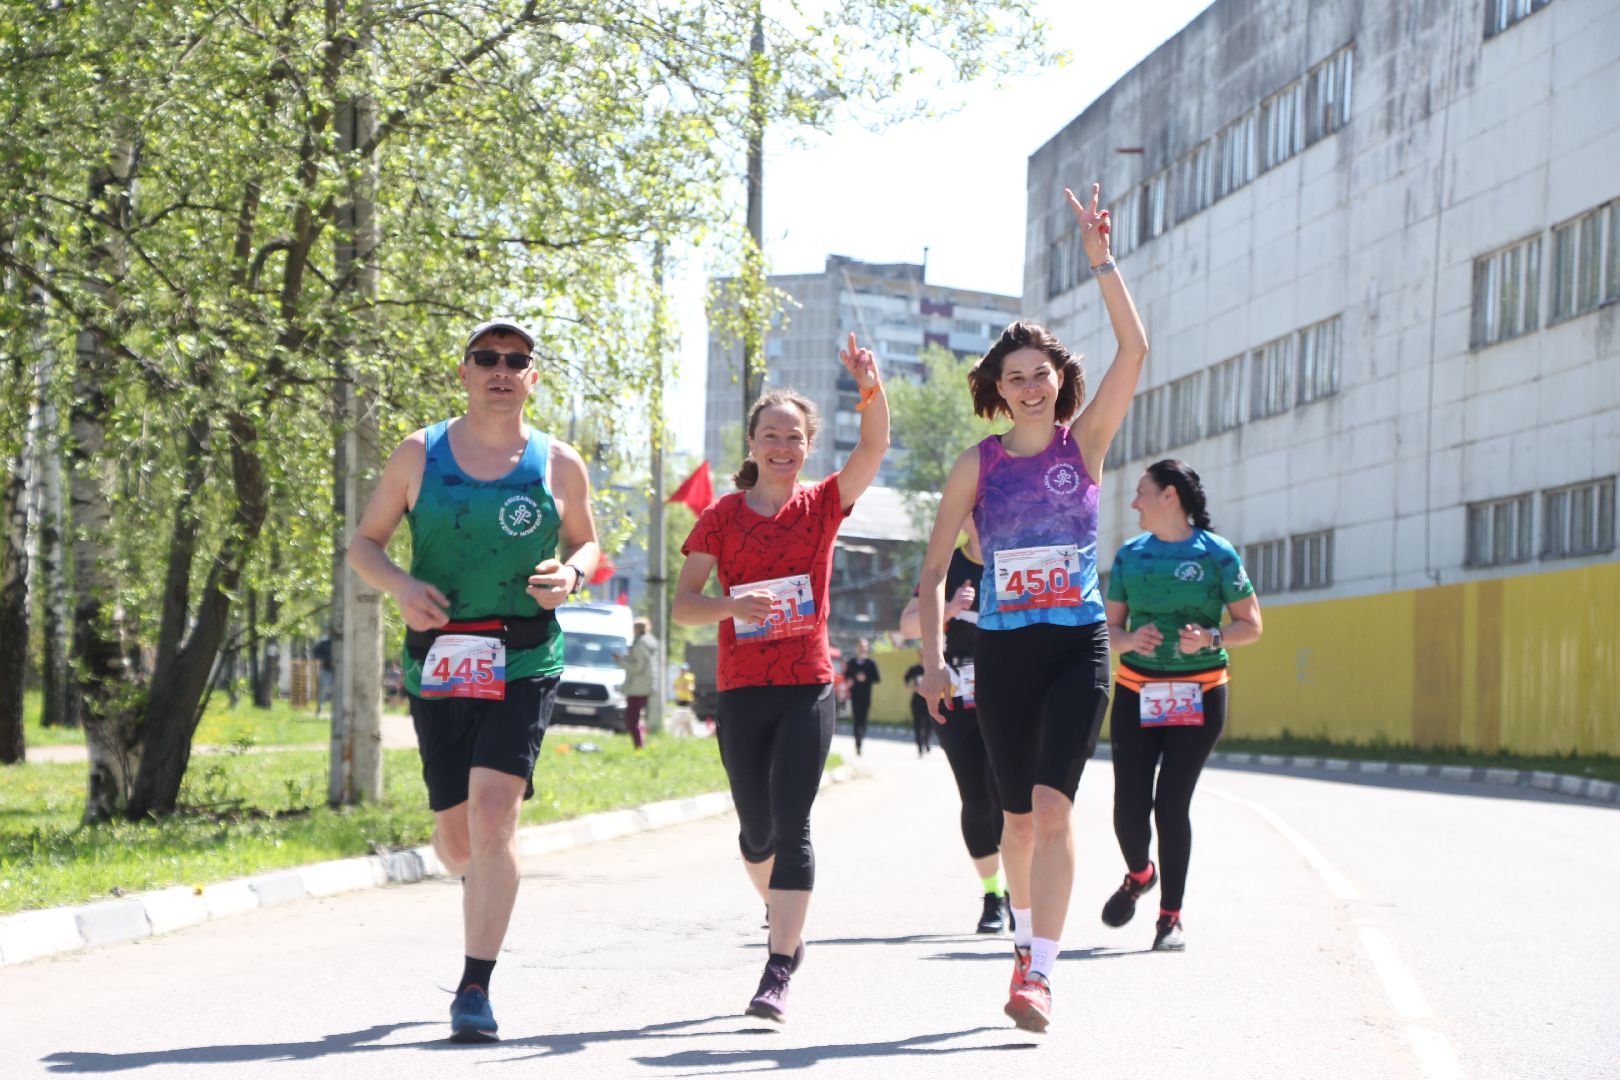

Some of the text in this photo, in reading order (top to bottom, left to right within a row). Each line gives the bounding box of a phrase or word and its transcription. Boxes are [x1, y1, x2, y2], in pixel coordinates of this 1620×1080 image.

[1005, 567, 1071, 596] 450
[753, 597, 804, 627] 51
[431, 656, 495, 685] 445
[1150, 698, 1195, 717] 323
